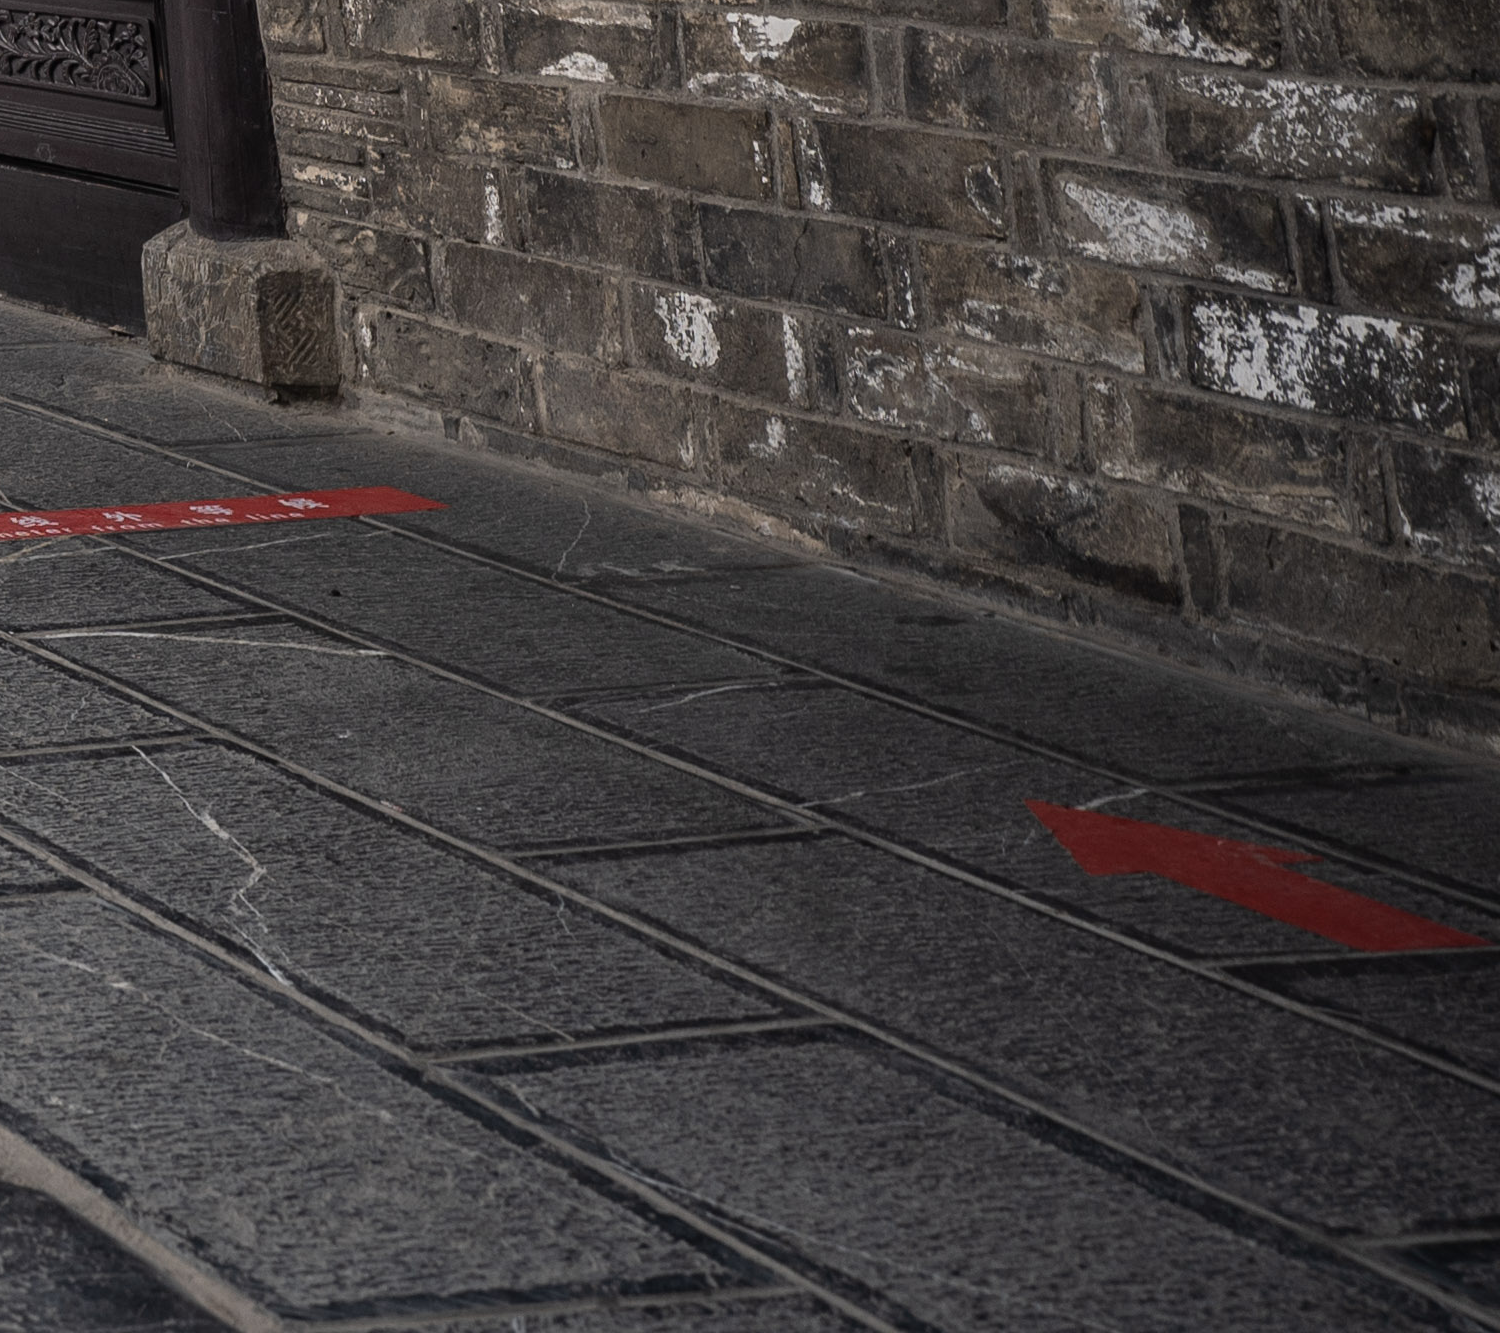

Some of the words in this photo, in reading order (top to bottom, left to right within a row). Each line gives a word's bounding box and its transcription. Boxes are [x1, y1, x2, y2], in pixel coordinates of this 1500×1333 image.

[92, 520, 164, 532] from
[181, 515, 230, 526] the
[245, 510, 306, 522] line
